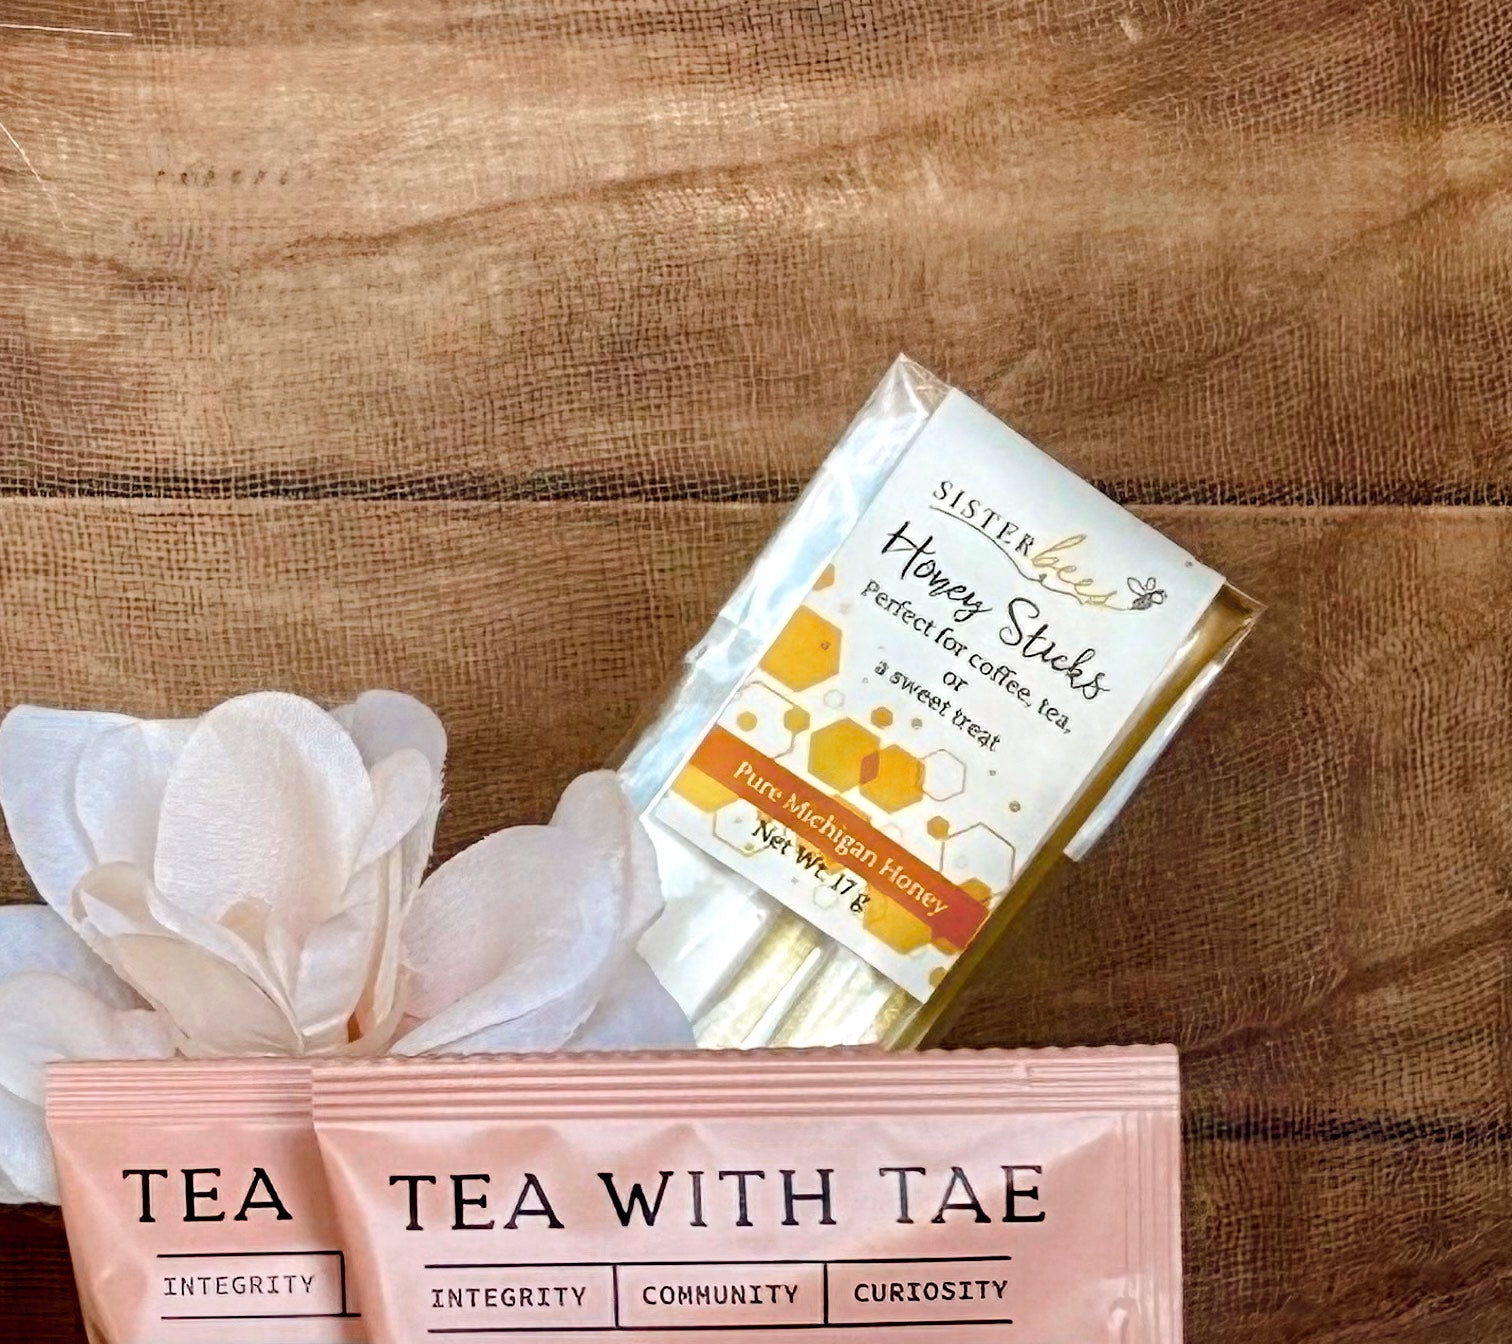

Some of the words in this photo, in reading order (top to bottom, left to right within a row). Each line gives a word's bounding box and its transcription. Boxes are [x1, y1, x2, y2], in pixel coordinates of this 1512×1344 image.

[861, 579, 938, 638] Perfect
[934, 627, 968, 658] for
[881, 520, 993, 623] Honey
[999, 597, 1110, 700] Sticks
[943, 670, 969, 693] or
[889, 670, 952, 719] sweet
[952, 707, 1001, 753] treat
[733, 761, 783, 803] Pure
[782, 792, 879, 869] Michigan
[878, 857, 949, 917] Honey
[752, 818, 793, 855] Net
[122, 1167, 294, 1223] TEA
[389, 1173, 565, 1232] TEA
[597, 1168, 838, 1230] WITH
[879, 1165, 1048, 1226] TAE
[163, 1274, 316, 1297] INTEGRITY
[430, 1284, 587, 1309] INTEGRITY
[641, 1282, 799, 1307] COMMUNITY
[853, 1279, 1009, 1305] CURIOSITY
